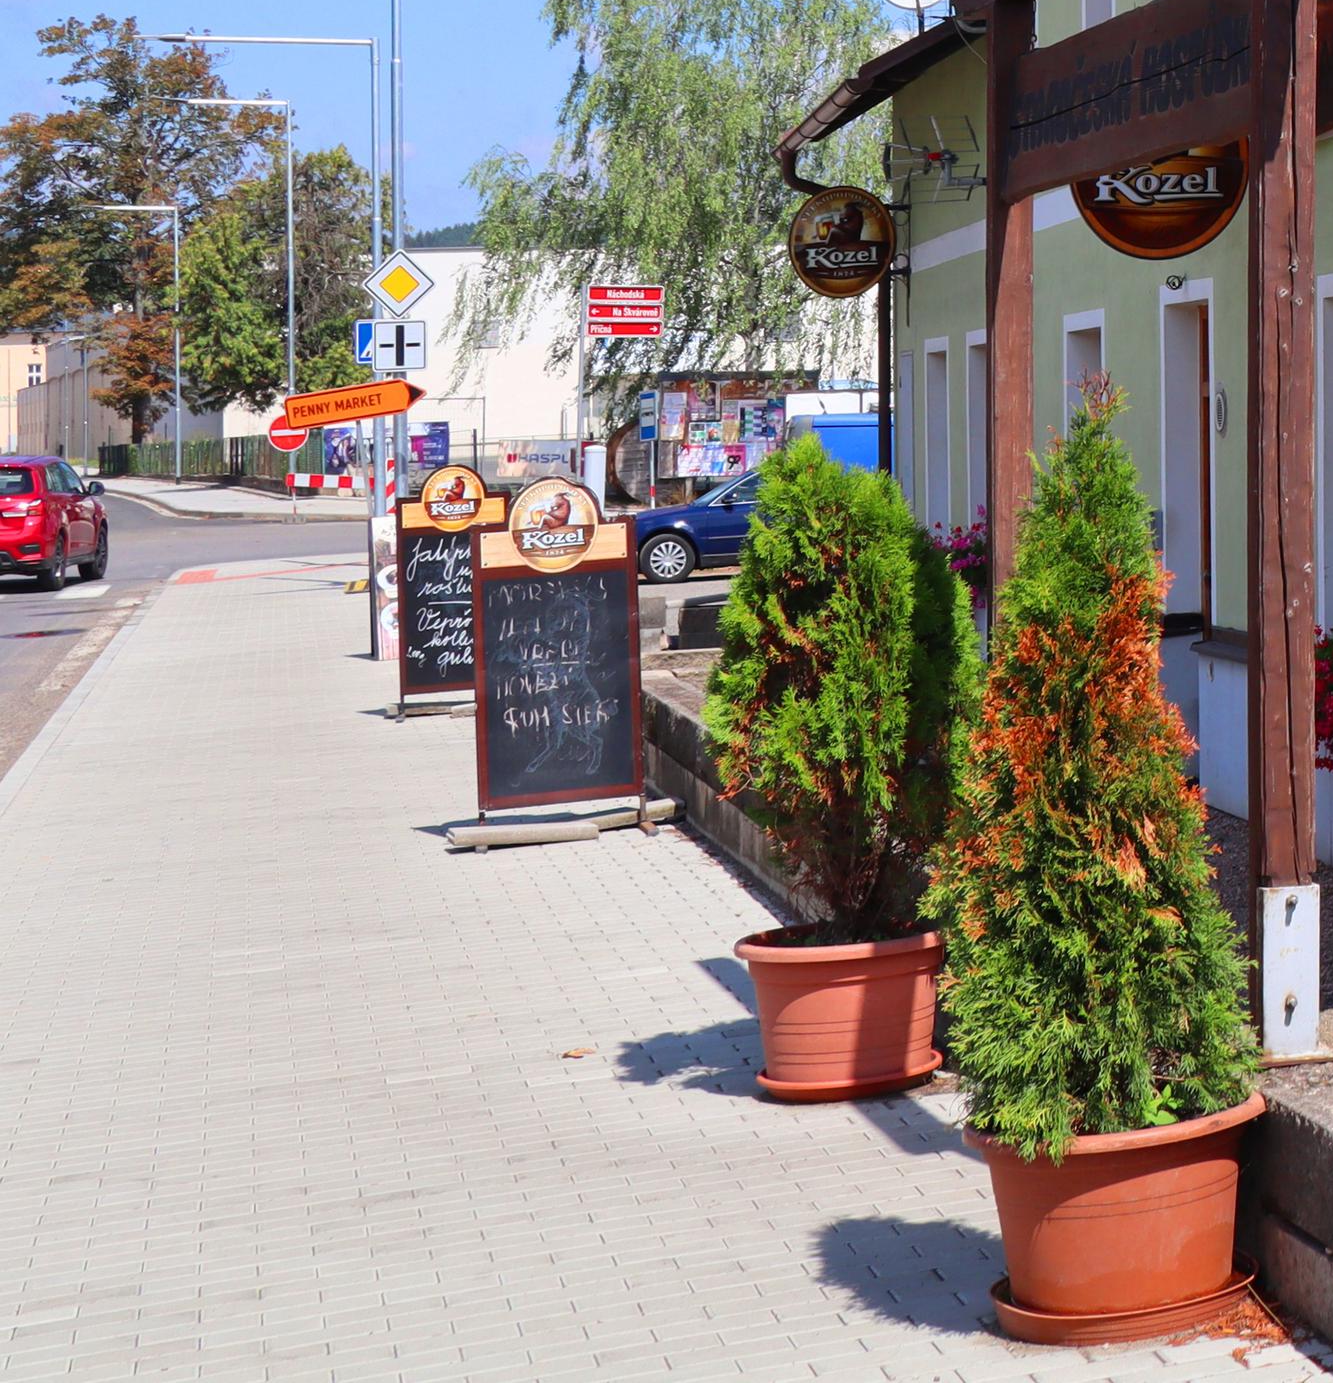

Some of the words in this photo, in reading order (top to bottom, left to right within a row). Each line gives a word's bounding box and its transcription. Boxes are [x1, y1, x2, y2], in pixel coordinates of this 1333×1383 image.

[1094, 165, 1224, 205] Kozel
[806, 246, 878, 269] Kozel
[607, 289, 645, 299] Náchodská
[613, 307, 622, 317] Na
[293, 402, 331, 418] PENNY
[335, 393, 382, 412] MARKET
[430, 500, 475, 517] Kozel
[521, 528, 586, 550] Kozel
